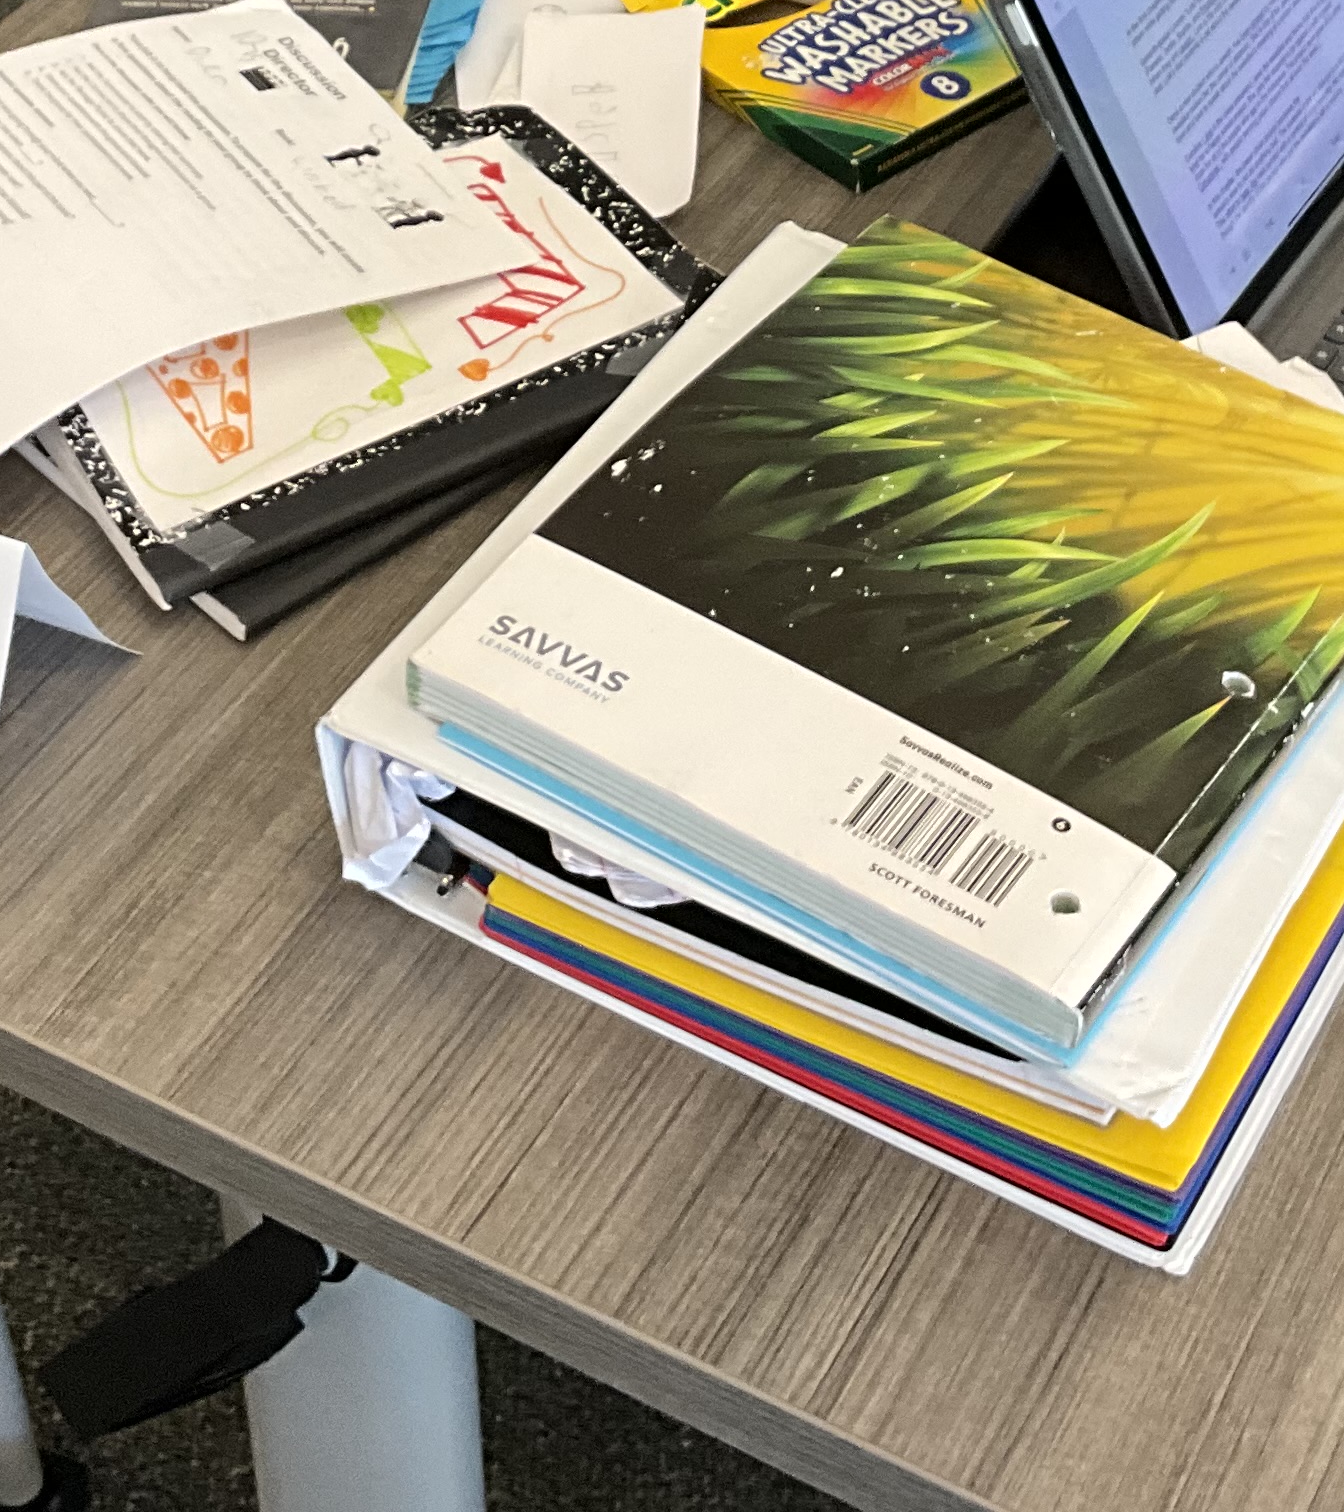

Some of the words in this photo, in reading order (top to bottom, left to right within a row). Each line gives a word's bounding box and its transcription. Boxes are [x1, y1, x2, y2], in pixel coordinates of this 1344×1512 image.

[263, 48, 318, 98] Director
[278, 35, 348, 101] Discussion
[820, 11, 970, 94] MARKERS
[930, 73, 960, 98] 8
[476, 634, 545, 672] LEARNING
[544, 664, 613, 705] COMPANY
[487, 613, 632, 695] SAVVAS
[867, 860, 911, 891] SCOTT
[911, 884, 986, 930] FORESMAN
